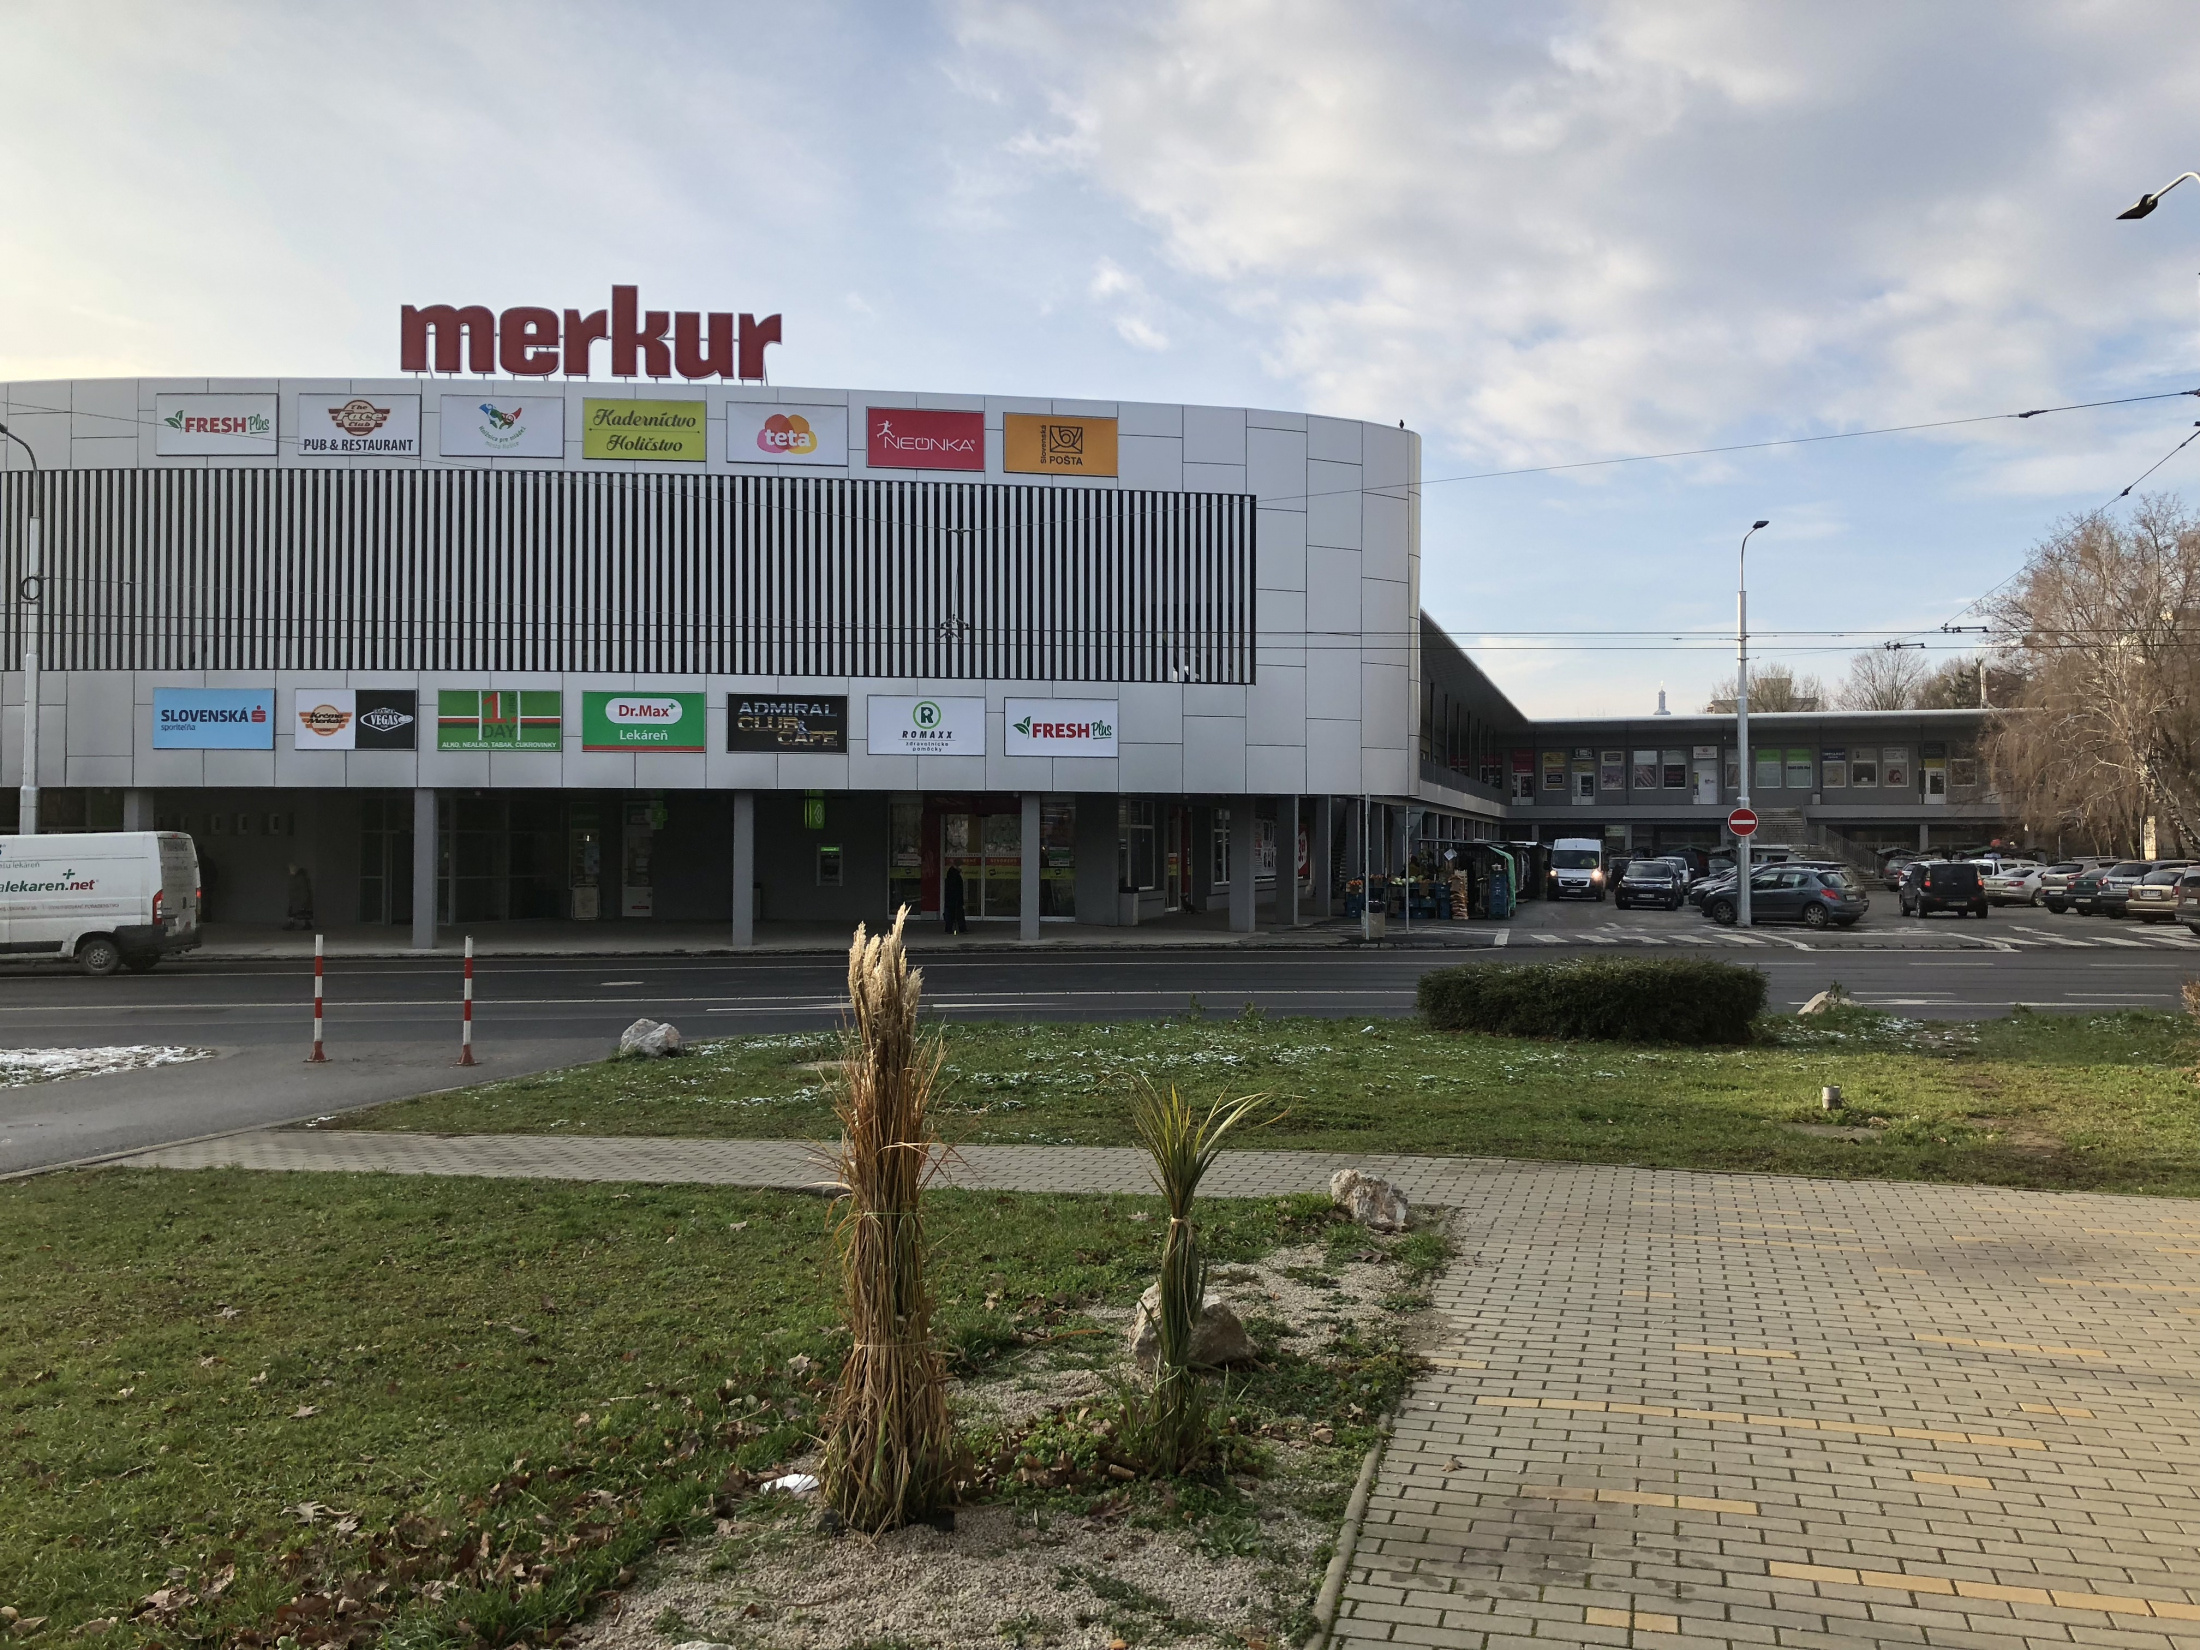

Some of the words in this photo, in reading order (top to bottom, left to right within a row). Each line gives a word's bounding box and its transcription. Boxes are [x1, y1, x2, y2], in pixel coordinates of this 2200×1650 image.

[400, 284, 782, 380] merkur
[337, 410, 383, 421] Face
[593, 408, 696, 428] Kaderníctvo
[185, 417, 246, 433] FRESH
[248, 413, 270, 431] Plus
[304, 439, 327, 451] PUB
[330, 439, 338, 450] &
[342, 439, 413, 451] RESTAURANT
[606, 434, 683, 451] Holičstvo
[765, 429, 810, 447] teta
[1049, 455, 1083, 466] POŠTA
[161, 707, 249, 722] SLOVENSKÁ
[619, 704, 669, 717] Dr.Max
[738, 702, 838, 717] ADMIRAL
[370, 714, 399, 725] VEGAS
[737, 716, 798, 732] CLUB
[161, 723, 196, 731] sporiteľňa
[482, 725, 517, 738] DAY
[1032, 723, 1090, 738] FRESH
[1091, 720, 1112, 736] Plus
[620, 730, 668, 741] Lekáreň
[902, 731, 953, 739] ROMAXX
